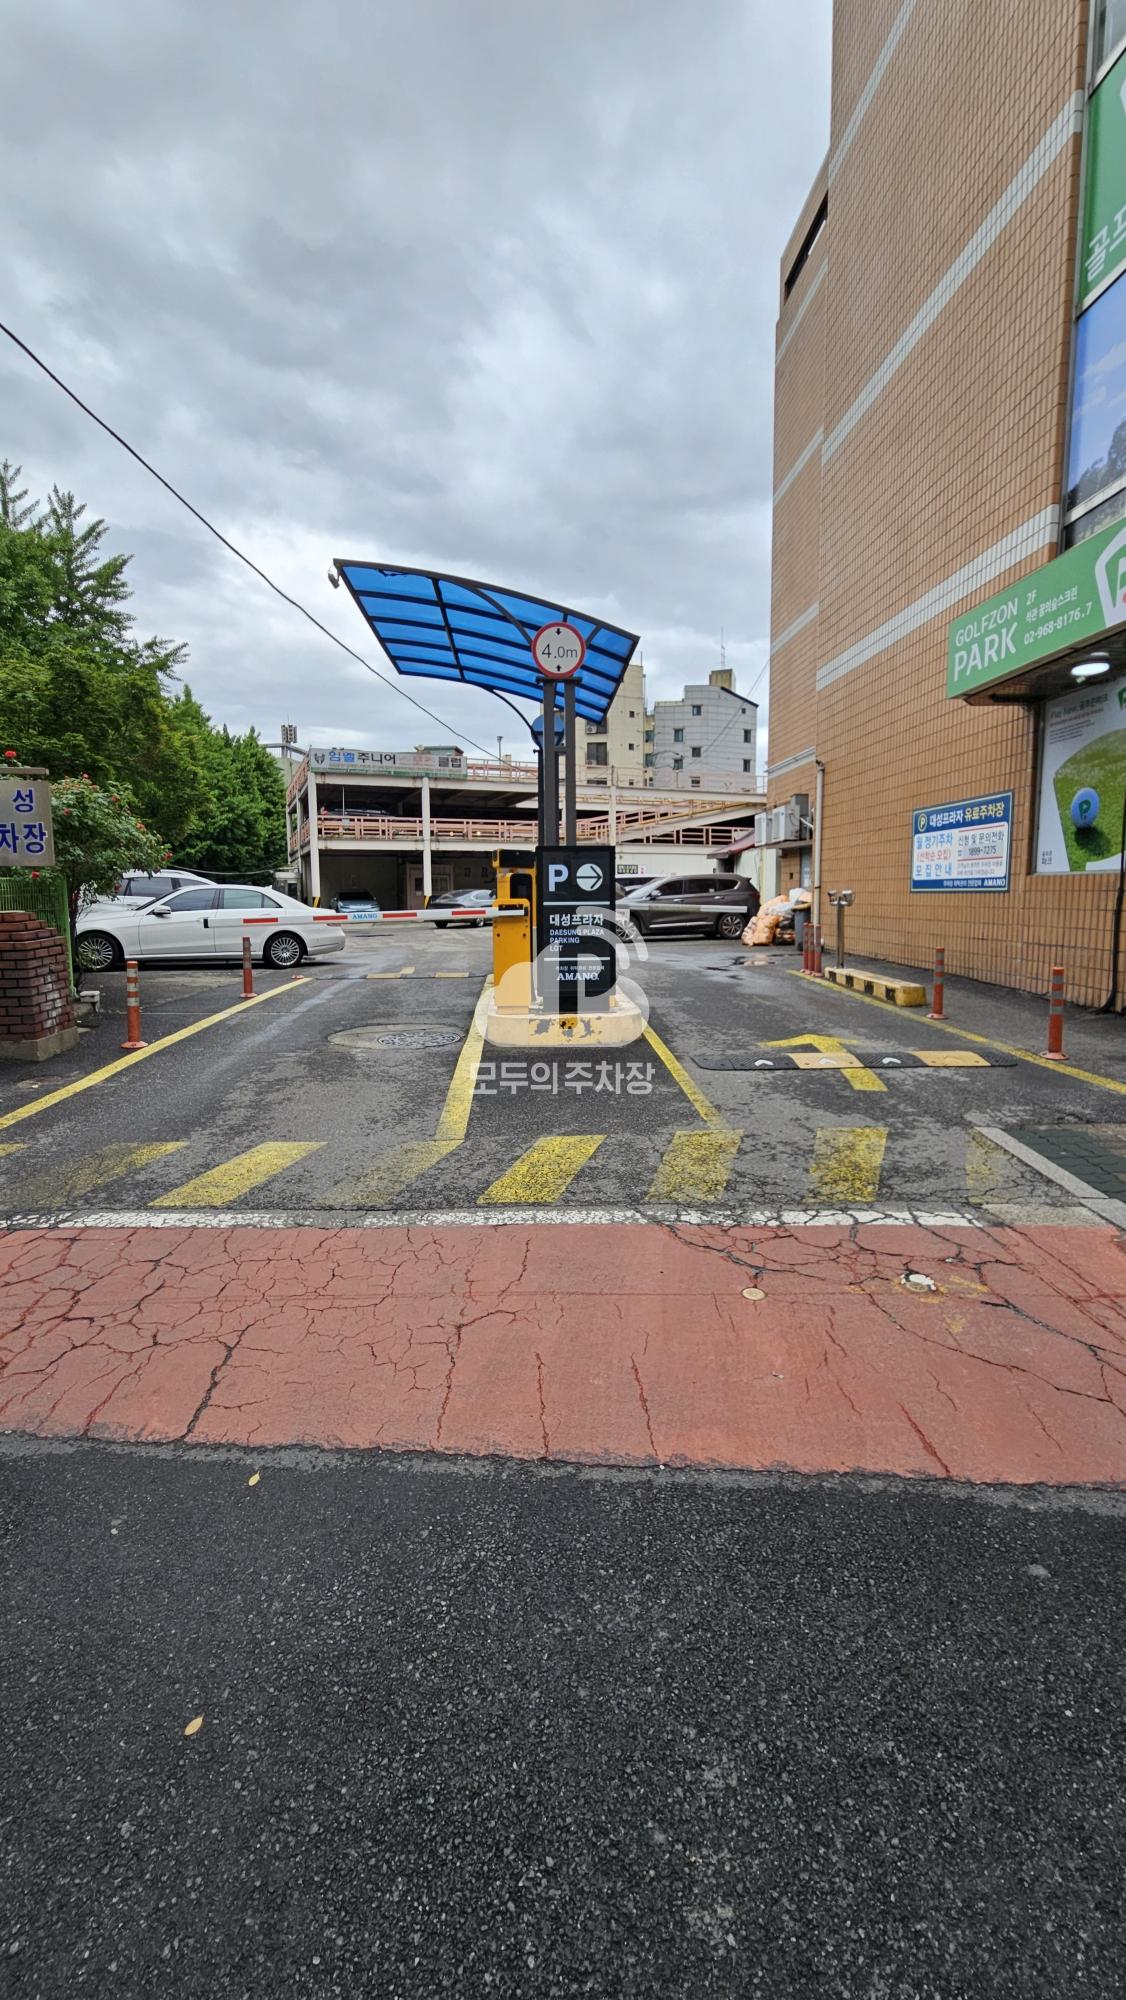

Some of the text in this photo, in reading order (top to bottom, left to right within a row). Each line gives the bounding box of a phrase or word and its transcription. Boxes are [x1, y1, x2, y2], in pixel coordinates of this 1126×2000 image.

[1026, 589, 1037, 606] 2F
[955, 597, 1019, 647] GOLFZON
[541, 643, 578, 659] 4.0m
[954, 621, 1018, 682] PARK
[357, 752, 396, 765] 주니어
[12, 789, 34, 813] 성
[929, 801, 1005, 827] 대성프라자 유료주차장
[548, 864, 569, 892] P
[984, 878, 1006, 887] AMANO
[352, 912, 378, 920] AMANO
[549, 913, 604, 926] 대성프라자
